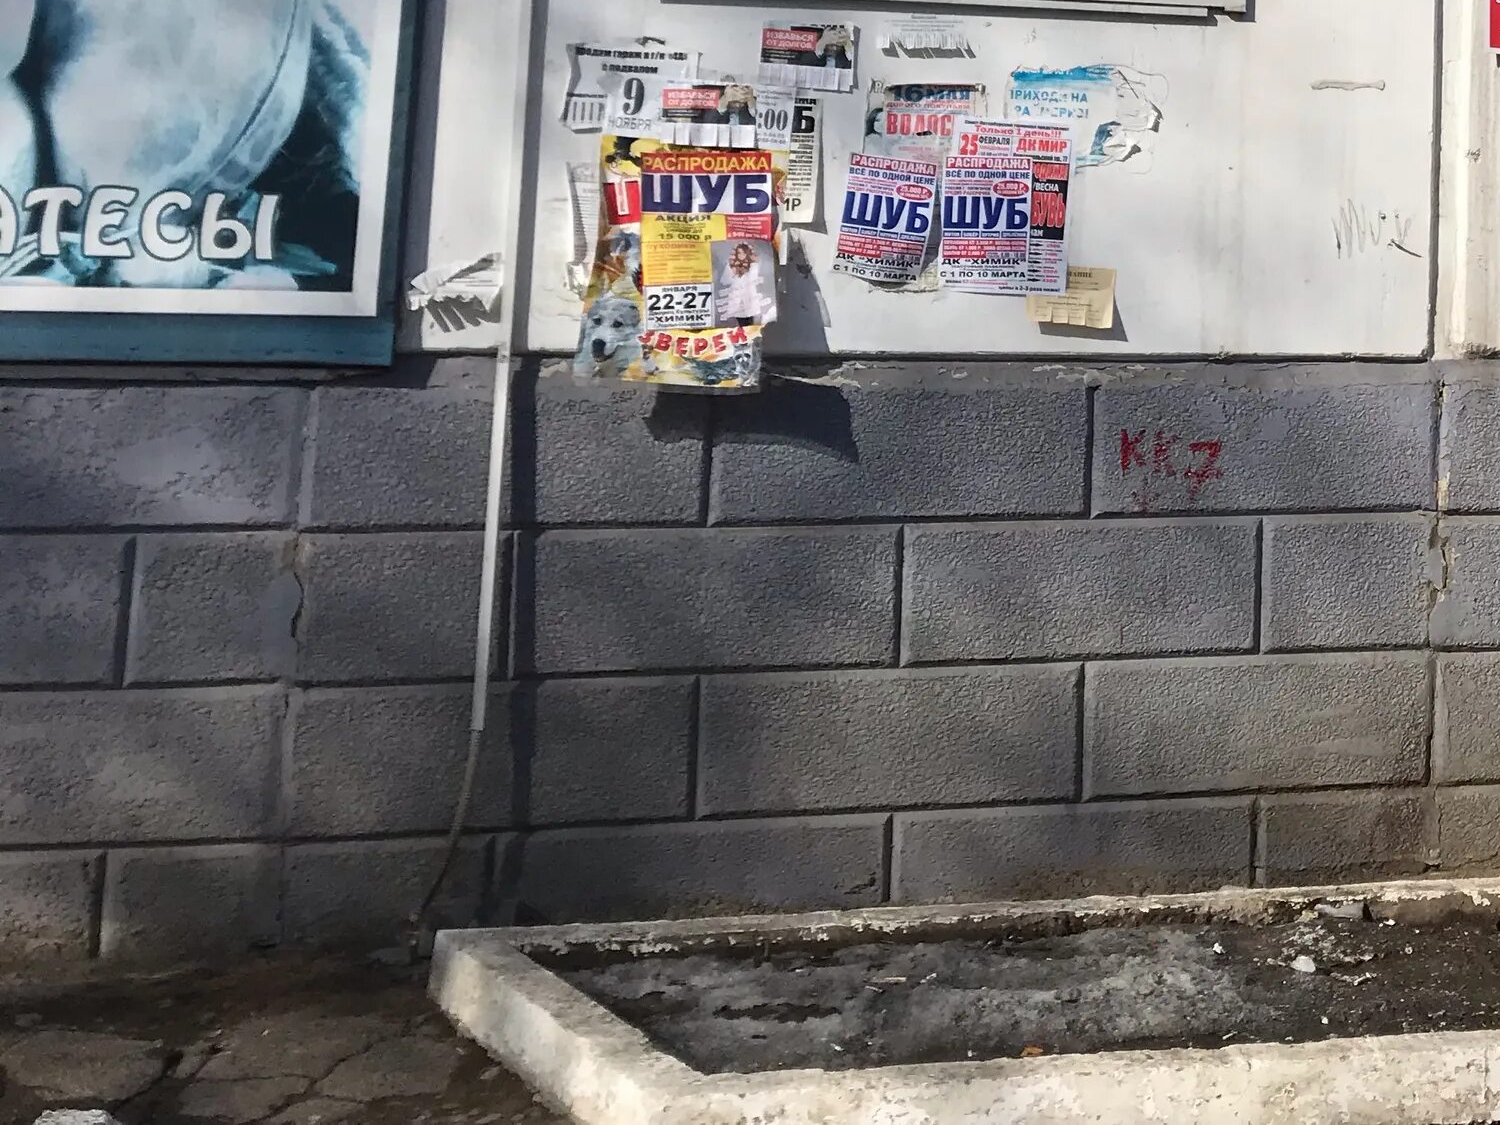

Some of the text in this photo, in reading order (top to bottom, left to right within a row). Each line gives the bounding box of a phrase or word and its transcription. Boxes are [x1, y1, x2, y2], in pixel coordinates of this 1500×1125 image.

[622, 77, 645, 115] 9
[1071, 92, 1088, 103] НА
[886, 112, 955, 136] ВОЛОС
[975, 124, 1014, 135] Только
[960, 133, 979, 156] 25
[978, 135, 1011, 146] ФЕВРАЛЯ
[1016, 138, 1038, 153] ДК
[1038, 139, 1067, 153] МИР
[643, 156, 770, 173] РАСПРОДАЖА
[852, 154, 935, 175] РАСПРОДАЖА
[947, 157, 1030, 170] РАСПРОДАЖА
[849, 166, 866, 175] ВСЁ
[868, 170, 880, 178] ПО
[882, 171, 911, 182] ОДНОЙ
[913, 177, 936, 186] ЦЕНЕ
[945, 169, 1031, 180] ВСЁ ПО ОДНОЙ ЦЕНЕ
[641, 174, 770, 214] ШУБ
[841, 190, 930, 234] ШУБ
[943, 195, 1029, 230] ШУБ
[1031, 191, 1065, 228] БУВЬ
[655, 213, 711, 224] АКЦИЯ
[678, 233, 700, 241] 000
[835, 252, 855, 261] ДК
[941, 258, 961, 266] ДК
[851, 267, 866, 275] ПО
[883, 271, 917, 281] МАРТА
[991, 271, 1026, 279] МАРТА
[648, 291, 712, 311] 22-27
